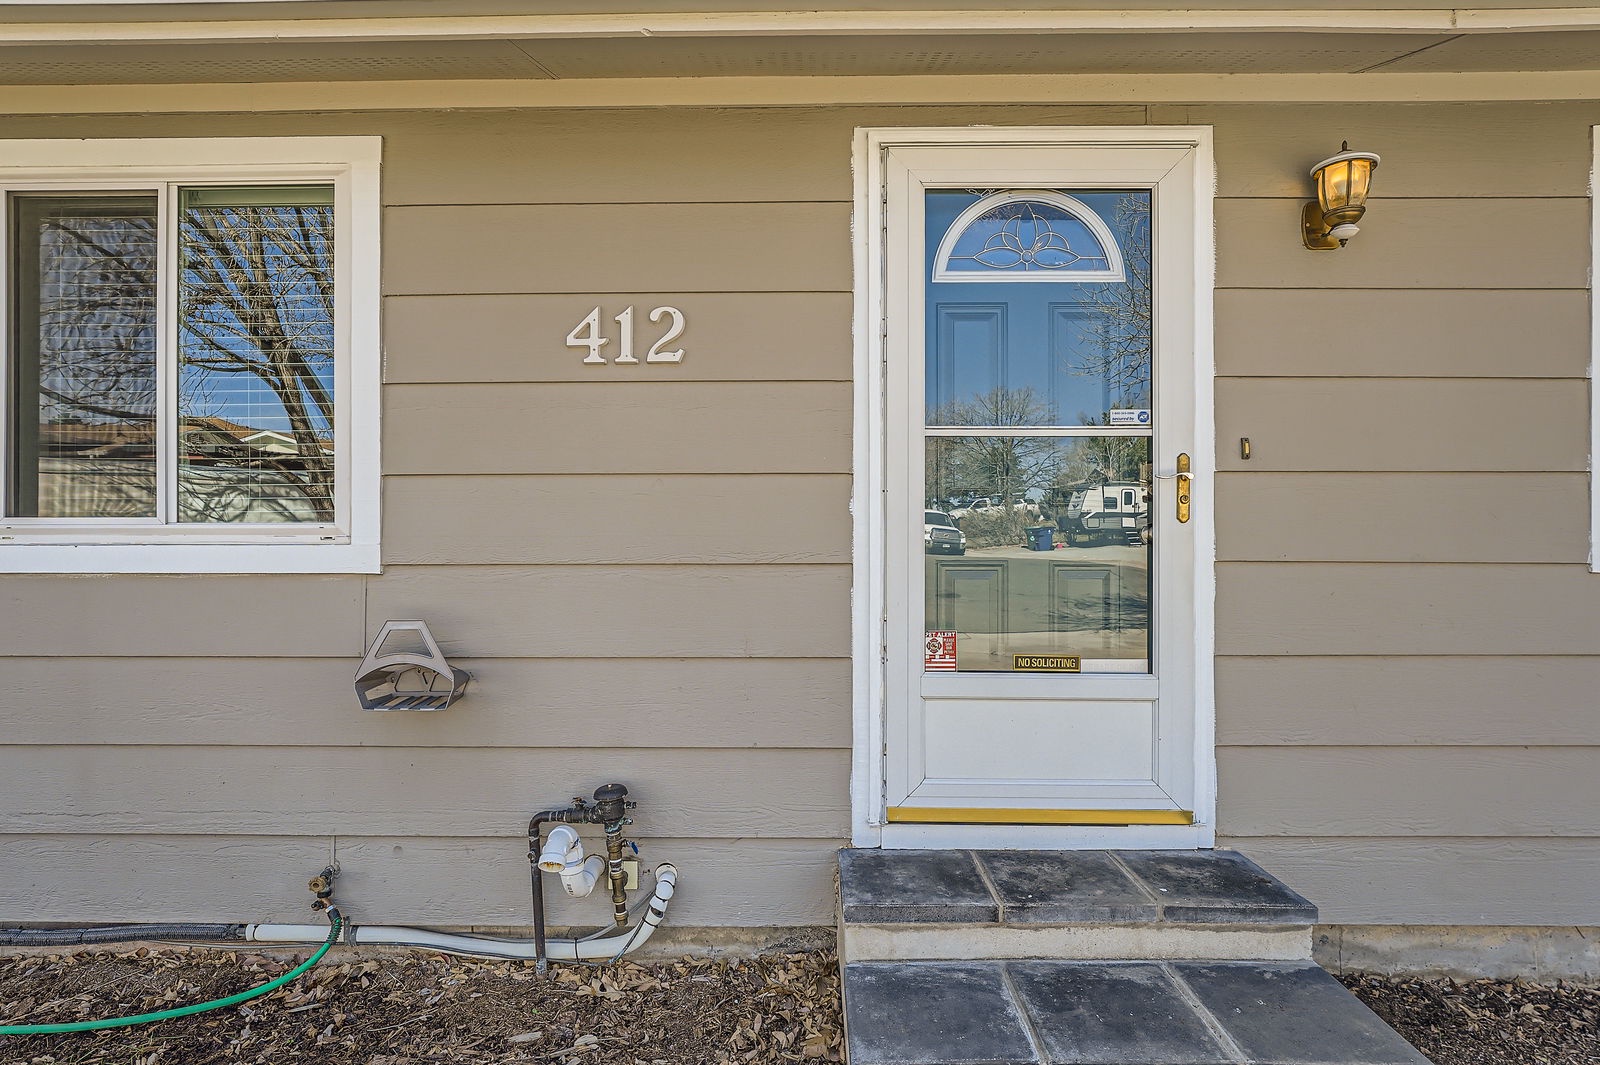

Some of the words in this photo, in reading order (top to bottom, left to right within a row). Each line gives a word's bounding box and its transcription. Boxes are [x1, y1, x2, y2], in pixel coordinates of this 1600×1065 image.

[566, 305, 686, 364] 412
[1018, 658, 1031, 667] NO
[1031, 658, 1076, 668] SOLICITING
